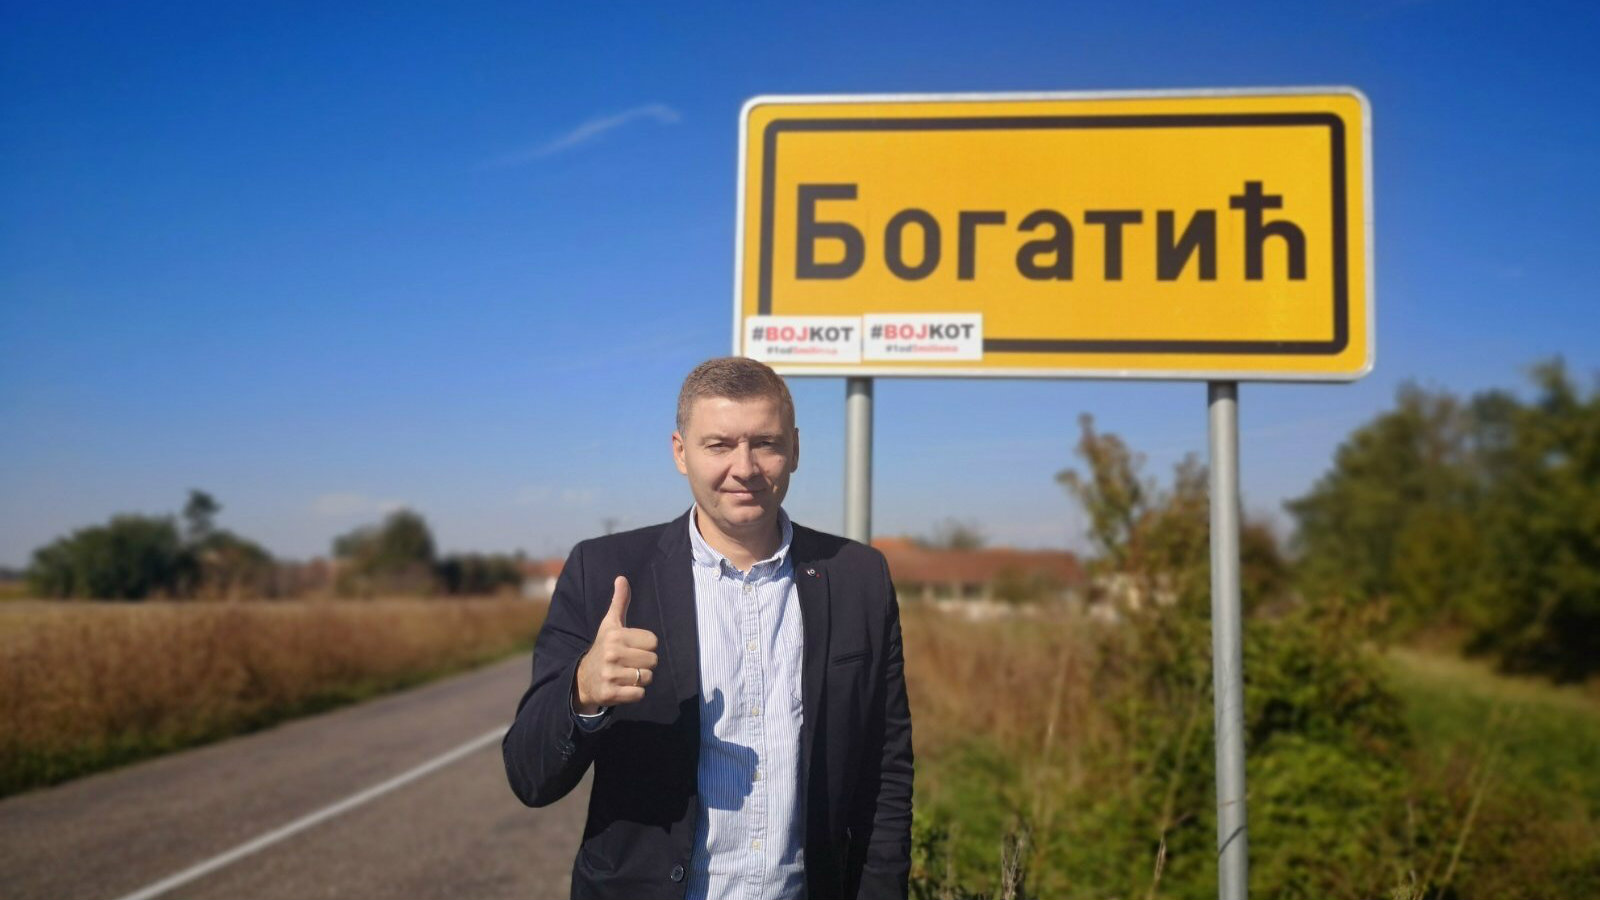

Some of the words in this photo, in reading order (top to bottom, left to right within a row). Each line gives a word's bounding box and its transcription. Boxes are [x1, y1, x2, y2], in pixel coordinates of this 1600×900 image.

[795, 180, 1307, 282] Богатић
[752, 326, 854, 342] #BOJKOT
[870, 323, 975, 340] #BOJKOT
